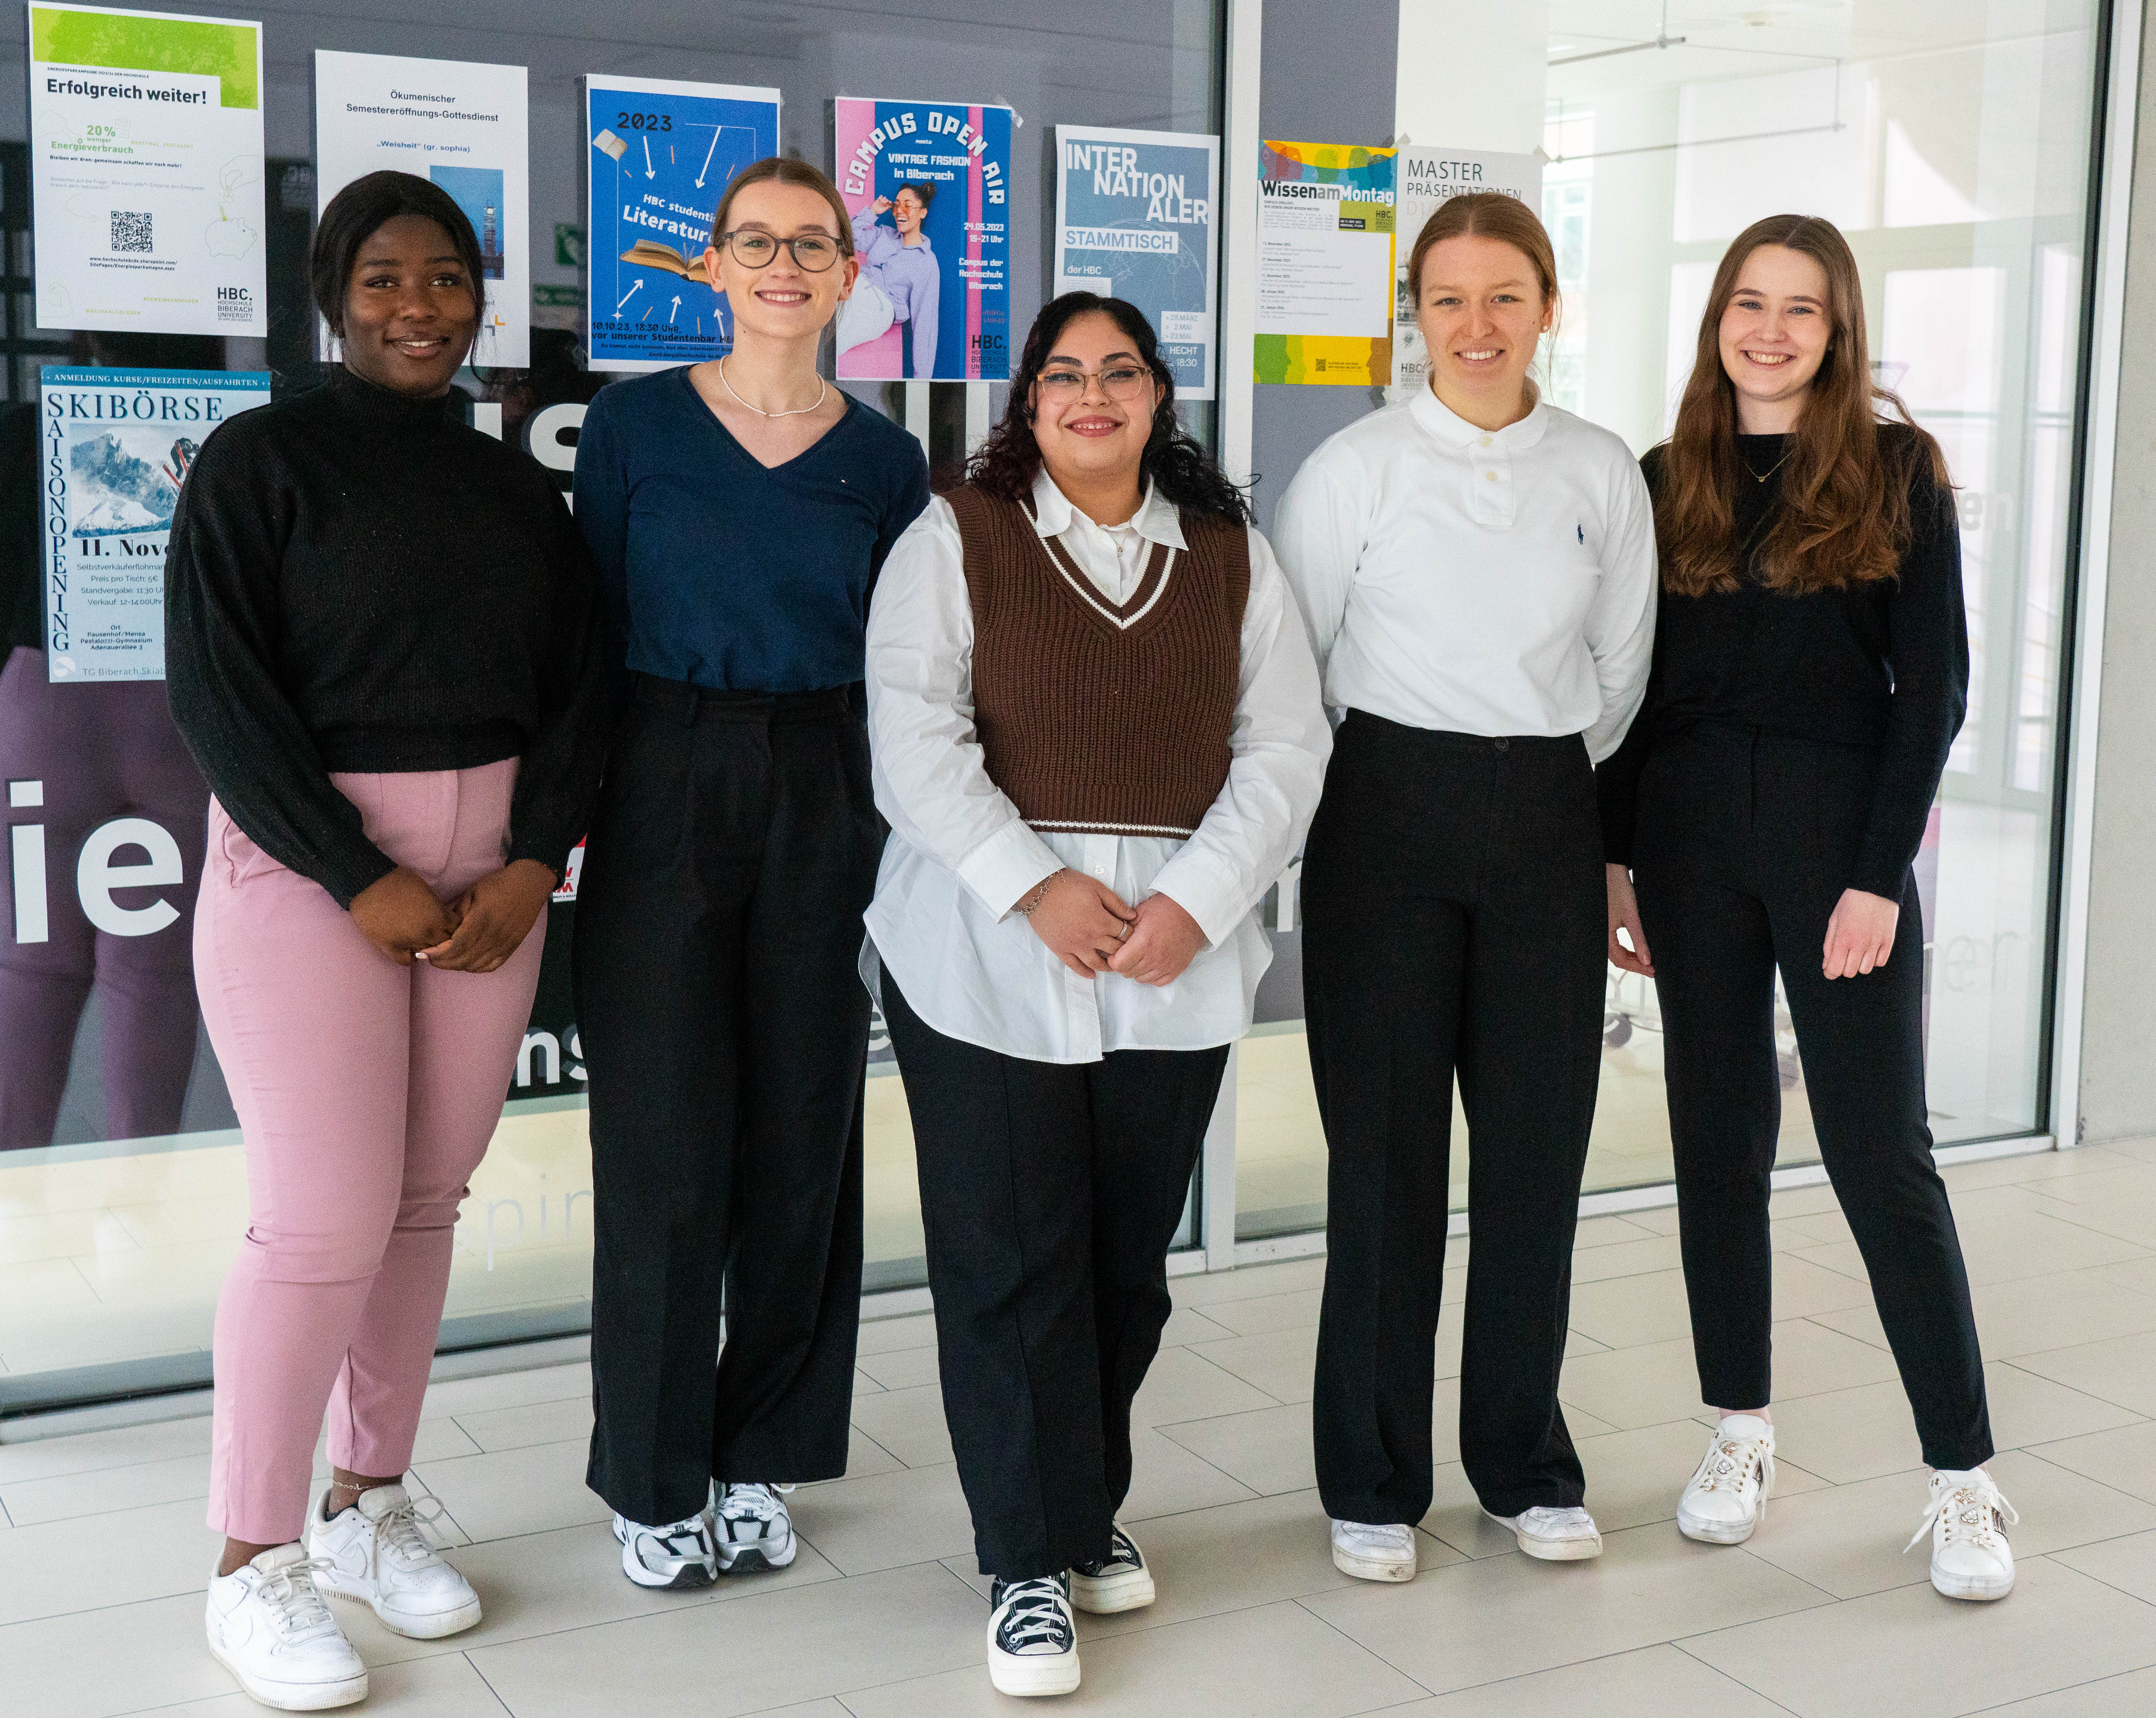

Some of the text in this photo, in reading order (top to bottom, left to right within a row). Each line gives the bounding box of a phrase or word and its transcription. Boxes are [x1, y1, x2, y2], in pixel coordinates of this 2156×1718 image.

[47, 79, 206, 104] Erfolgreich weiter!
[391, 89, 456, 103] Ökumenischer
[346, 103, 499, 122] Semestereröffnungs-Gottesdienst
[617, 112, 672, 132] 2023
[87, 125, 116, 137] 20 %
[51, 141, 133, 154] Energieverbrauch
[424, 143, 437, 151] (gr.
[440, 145, 470, 154] sophia)
[844, 111, 1005, 204] CAMPUS OPEN AIR
[888, 153, 971, 167] VINTAGE FASHION
[1067, 144, 1137, 173] INTER
[894, 168, 954, 181] in Biberach
[1408, 159, 1483, 182] MASTER
[1094, 170, 1184, 199] NATION
[643, 193, 666, 208] HBC
[1146, 196, 1208, 225] ALER
[1376, 210, 1393, 218] HBC.
[964, 222, 1004, 232] 24.05.2023
[969, 235, 989, 243] 15-21
[1065, 230, 1173, 250] STAMMTISCH
[959, 258, 988, 267] Campus
[959, 270, 1003, 279] Hochschule
[1067, 265, 1102, 274] der HBC
[218, 287, 252, 301] HBC.
[611, 333, 647, 341] unserer
[652, 333, 716, 343] Studentenbar
[971, 335, 1007, 350] HBC.
[1169, 346, 1198, 355] HECHT
[1176, 358, 1197, 367] 18:30
[54, 374, 258, 387] ANMELDUNG KURSE/FREIZEITEN/AUSFAHRTEN
[48, 390, 224, 421] SKIBÖRSE
[81, 587, 135, 596] Standvergabe:
[84, 668, 95, 676] TG
[99, 667, 139, 676] Biberach
